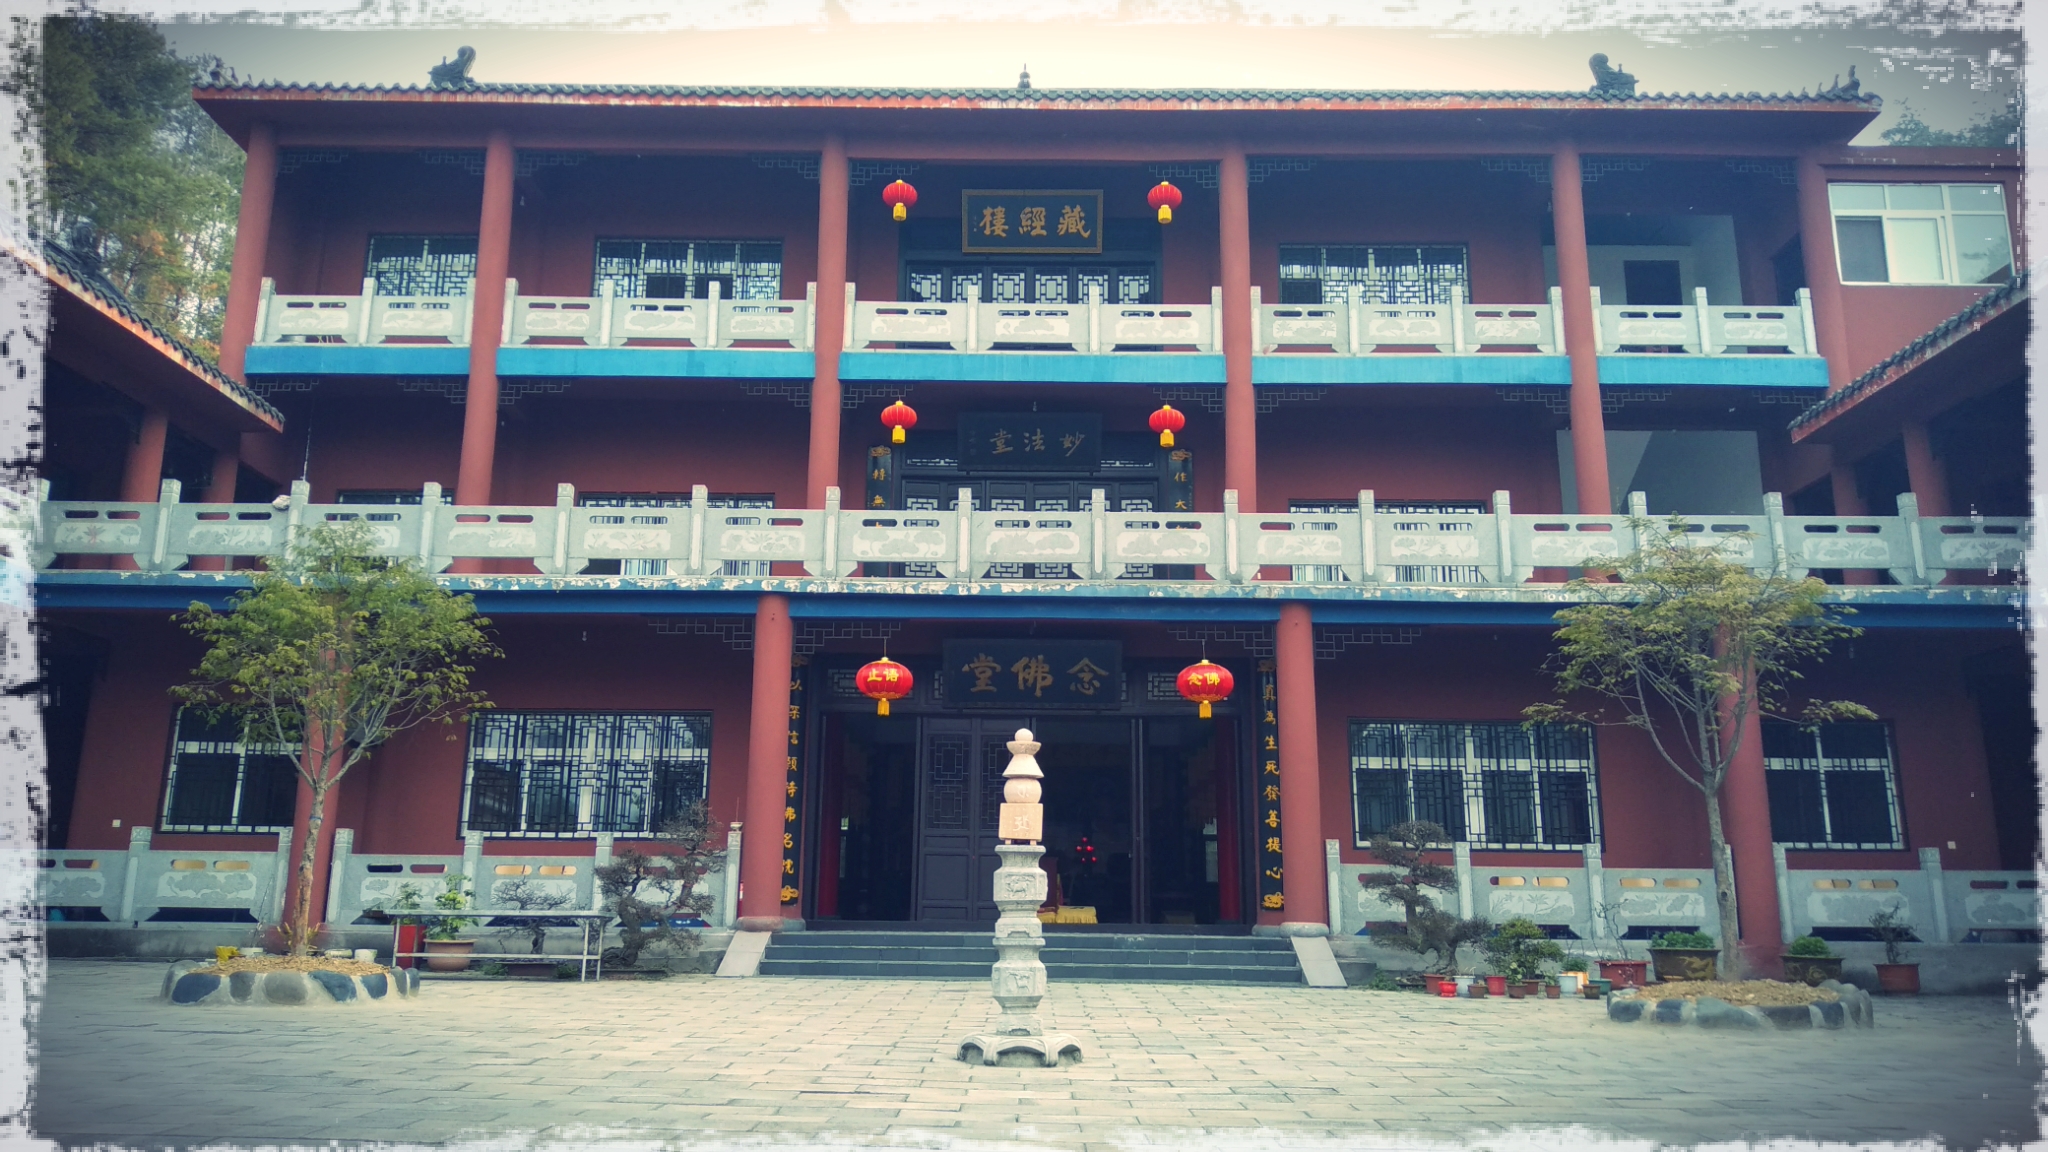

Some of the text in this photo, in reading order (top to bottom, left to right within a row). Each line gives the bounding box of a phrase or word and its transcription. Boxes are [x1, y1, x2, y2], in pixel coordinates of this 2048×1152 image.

[980, 204, 1091, 239] 藏經樓
[989, 428, 1086, 458] 妙法堂
[961, 653, 1109, 697] 念佛堂
[1187, 672, 1220, 686] 念佛
